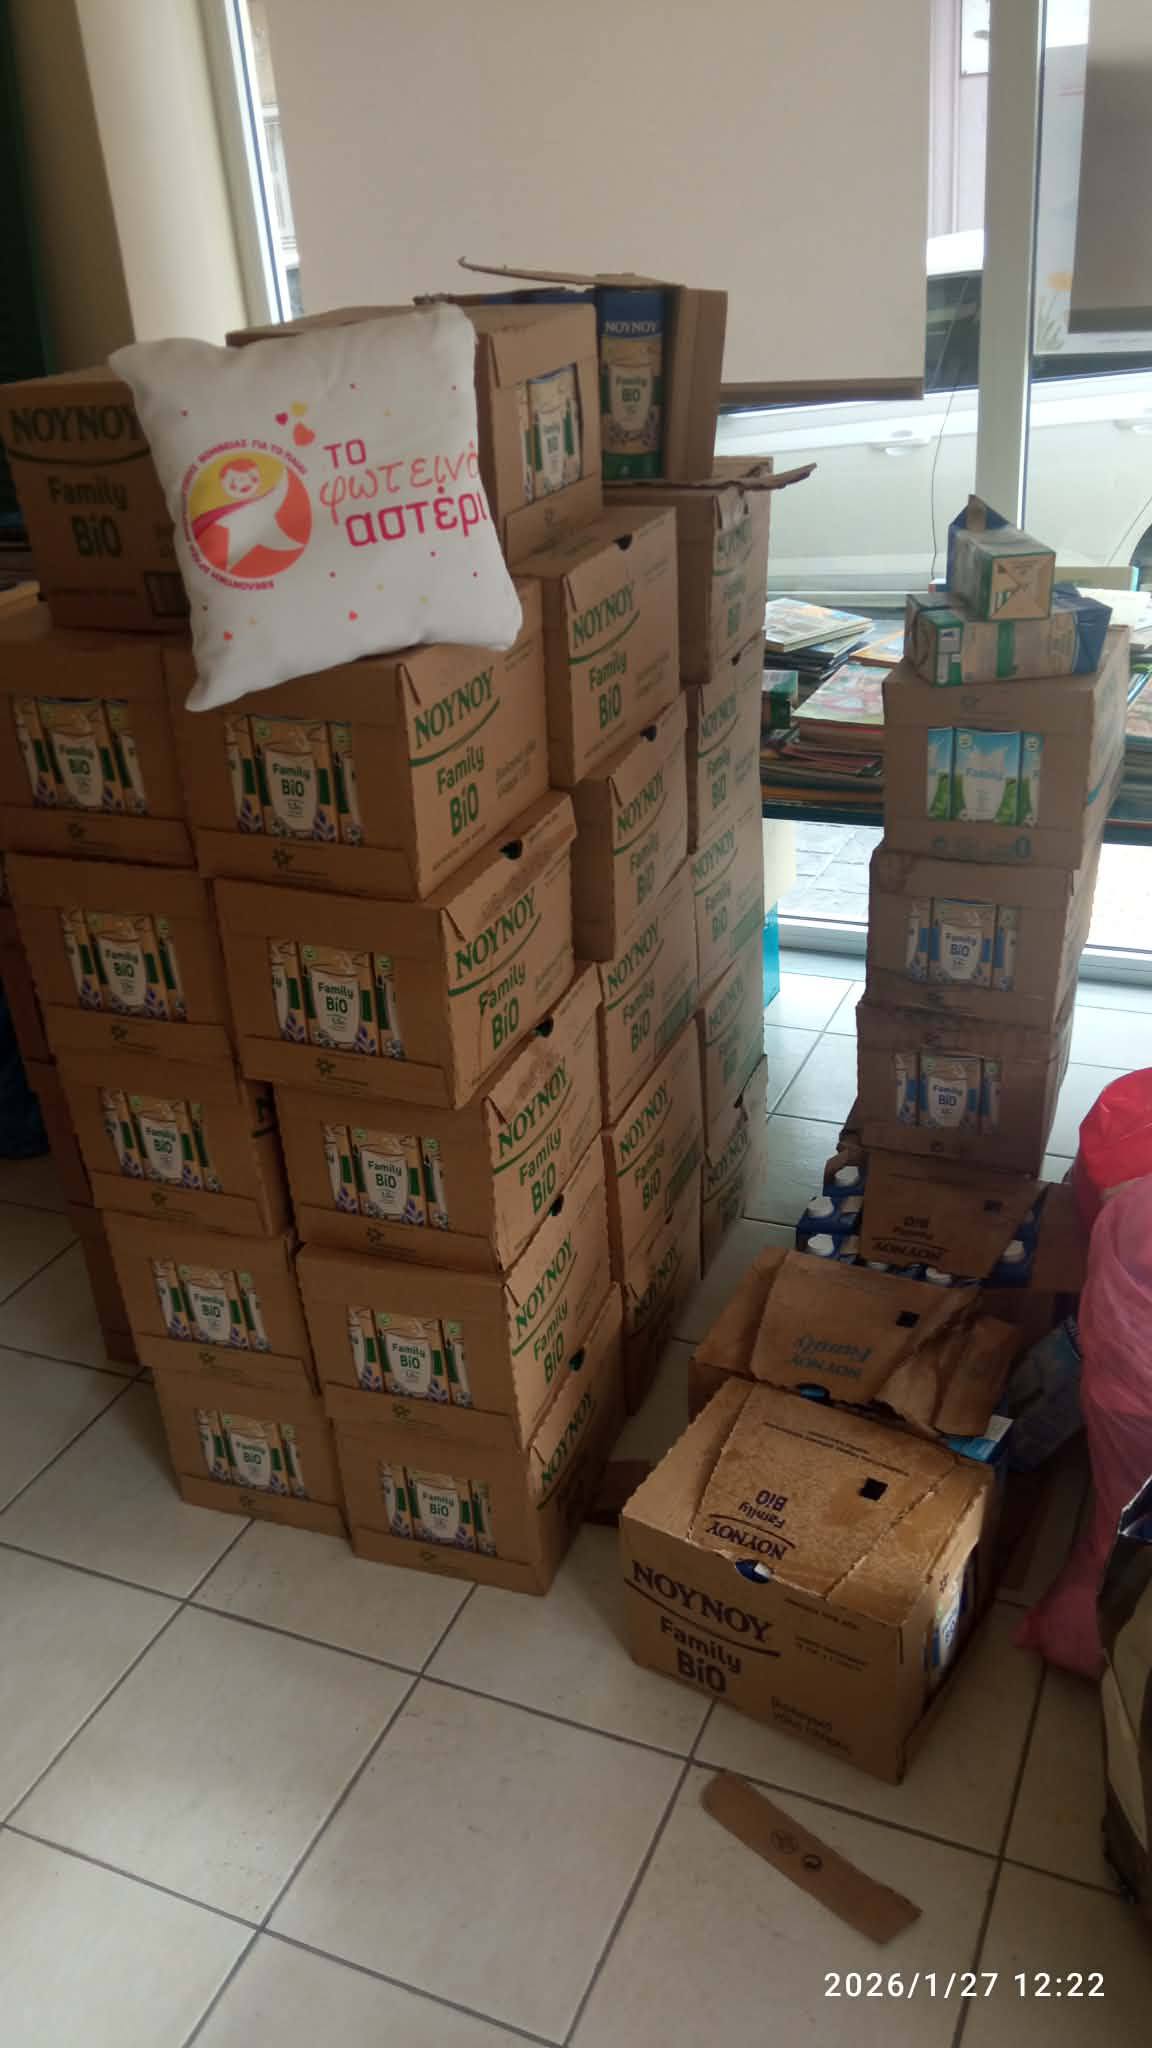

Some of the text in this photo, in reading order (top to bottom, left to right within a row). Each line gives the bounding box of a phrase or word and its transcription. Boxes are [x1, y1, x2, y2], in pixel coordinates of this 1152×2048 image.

[605, 320, 657, 334] NOYNOY
[47, 475, 129, 512] Family
[573, 580, 636, 649] NOYNOY
[589, 651, 628, 691] Family
[414, 665, 495, 749] NOYNOY
[436, 744, 484, 796] Family
[618, 767, 664, 840] NOYNOY
[455, 885, 536, 980] NOYNOY
[607, 915, 658, 998] NOYNOY
[318, 982, 354, 999] Family
[479, 960, 527, 1016] Family
[498, 1057, 567, 1157] NOYNOY
[368, 1160, 402, 1177] Family
[520, 1127, 562, 1186] Family
[515, 1232, 572, 1339] NOYNOY
[392, 1344, 426, 1358] Family
[534, 1298, 568, 1361] Family
[705, 1521, 788, 1560] NOYNOY
[738, 1501, 786, 1529] Family
[632, 1560, 774, 1643] NOYNOY
[660, 1616, 742, 1675] Family
